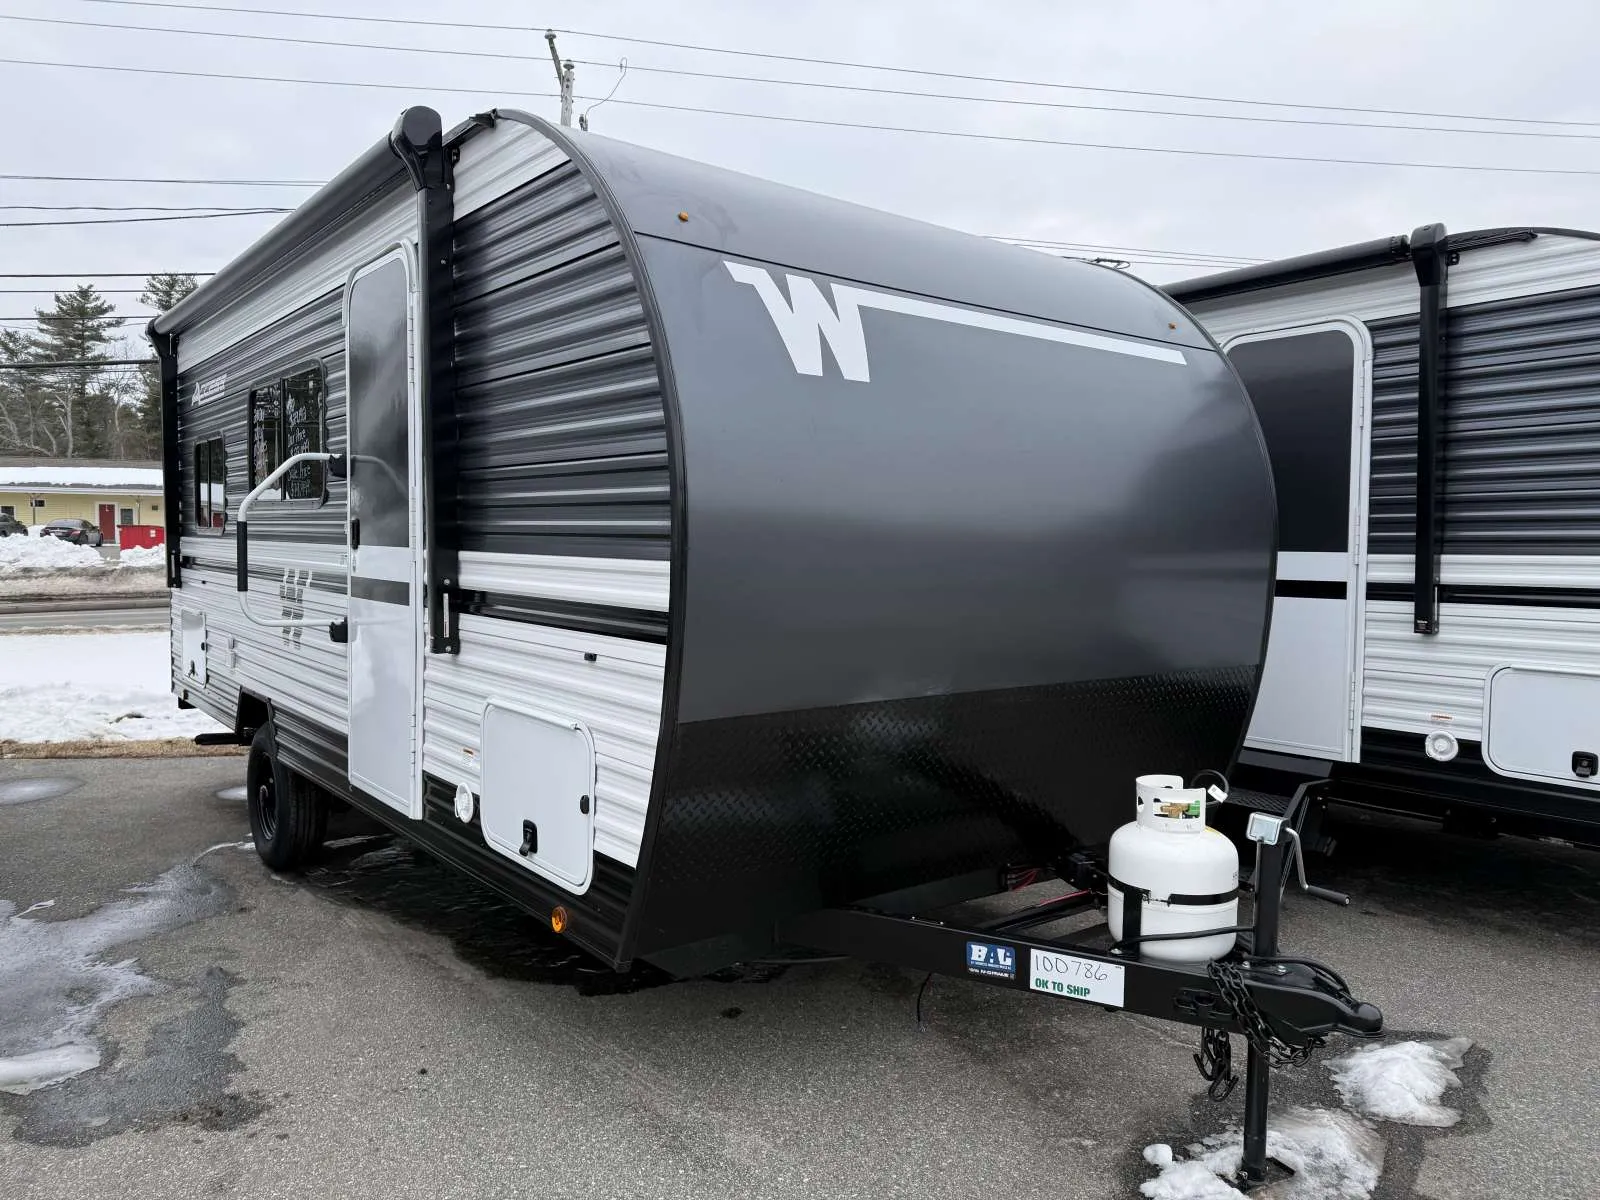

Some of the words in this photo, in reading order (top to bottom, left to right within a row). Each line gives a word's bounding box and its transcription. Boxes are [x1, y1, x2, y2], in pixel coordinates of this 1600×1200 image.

[1035, 978, 1049, 989] OK
[1051, 981, 1064, 993] TO
[1067, 985, 1090, 997] SHIP
